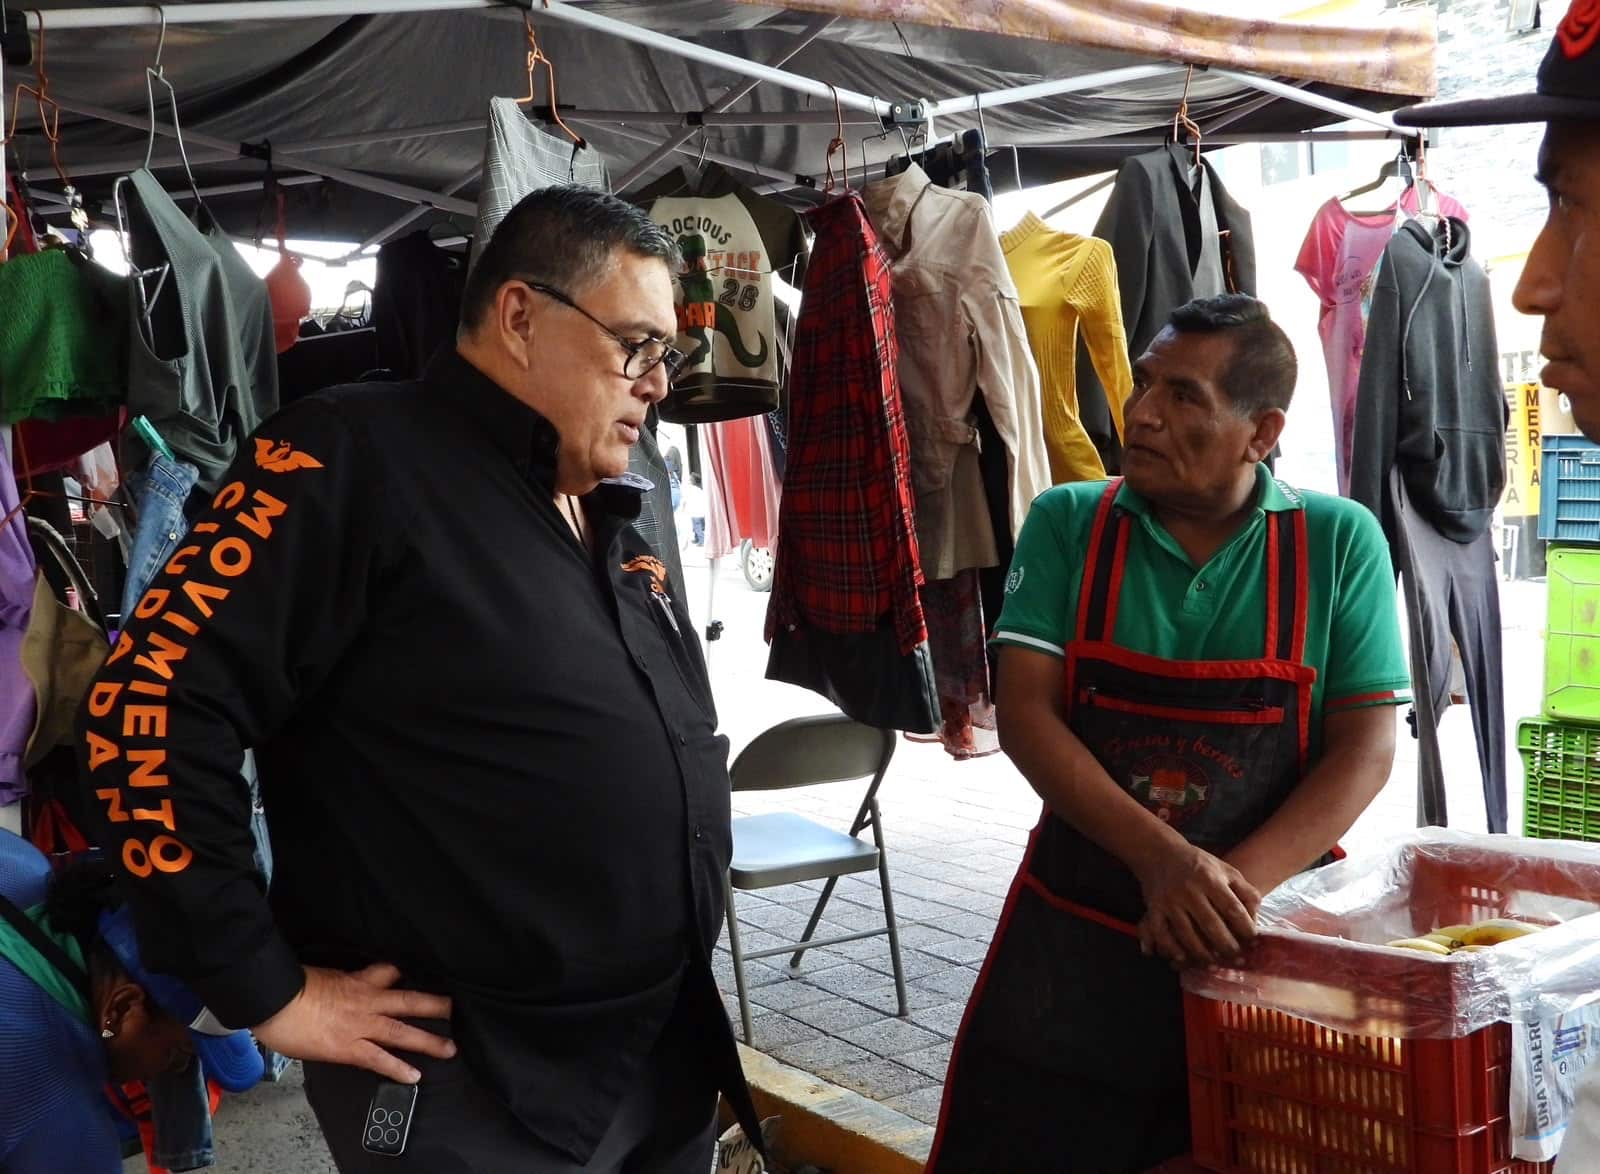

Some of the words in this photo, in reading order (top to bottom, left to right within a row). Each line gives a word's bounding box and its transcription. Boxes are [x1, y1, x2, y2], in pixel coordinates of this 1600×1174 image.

[660, 215, 733, 245] ROCIOUS
[123, 489, 288, 873] MOVIMIENTO
[1536, 1087, 1550, 1128] UNA
